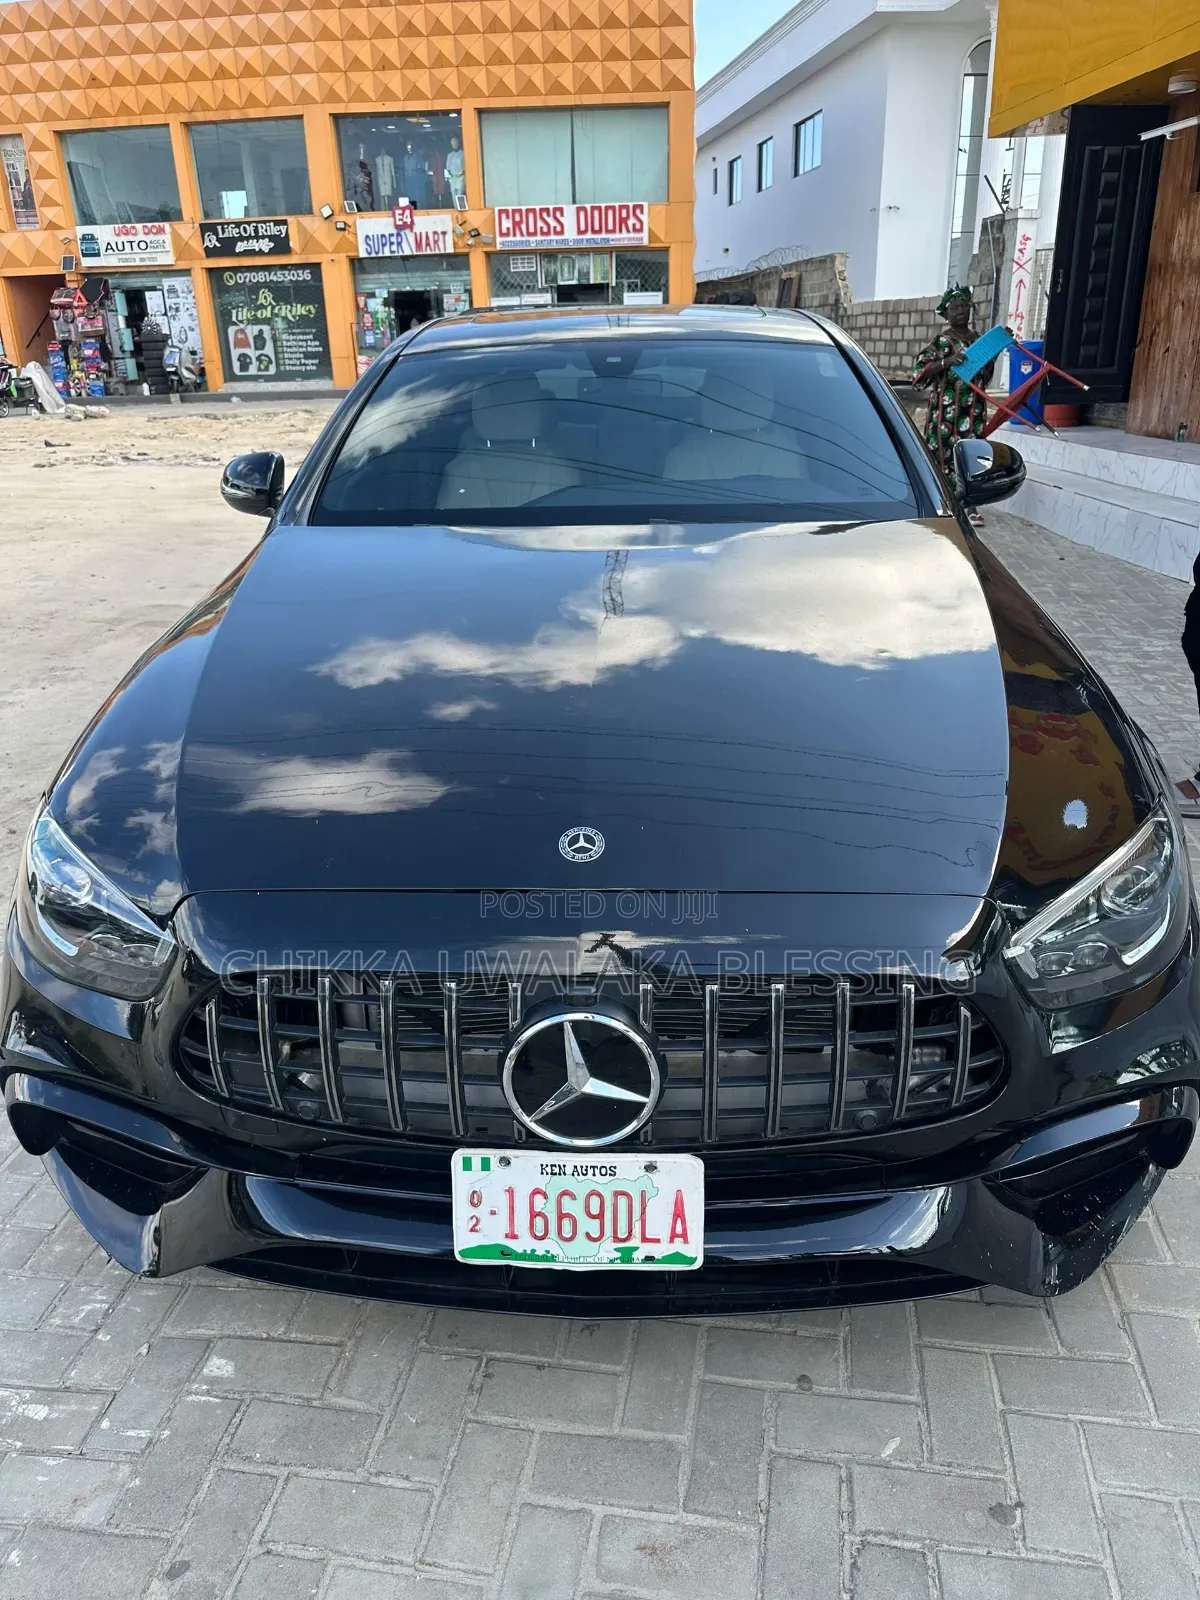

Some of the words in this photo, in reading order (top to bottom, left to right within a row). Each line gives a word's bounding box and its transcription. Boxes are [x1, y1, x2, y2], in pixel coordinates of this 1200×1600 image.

[395, 209, 412, 225] E4
[497, 206, 565, 237] CROSS
[575, 203, 645, 236] DOORS
[113, 225, 138, 236] UGO
[142, 224, 167, 235] DON
[216, 223, 241, 238] Life
[240, 223, 257, 237] Of
[257, 221, 287, 238] Riley
[104, 240, 149, 253] AUTO
[364, 231, 405, 255] SUPER
[414, 230, 448, 253] MART
[236, 269, 312, 284] 07081453036
[231, 308, 254, 326] Life
[272, 303, 318, 322] Riley
[540, 1163, 567, 1177] KEN
[571, 1165, 618, 1178] AUTOS
[593, 1255, 605, 1263] OF
